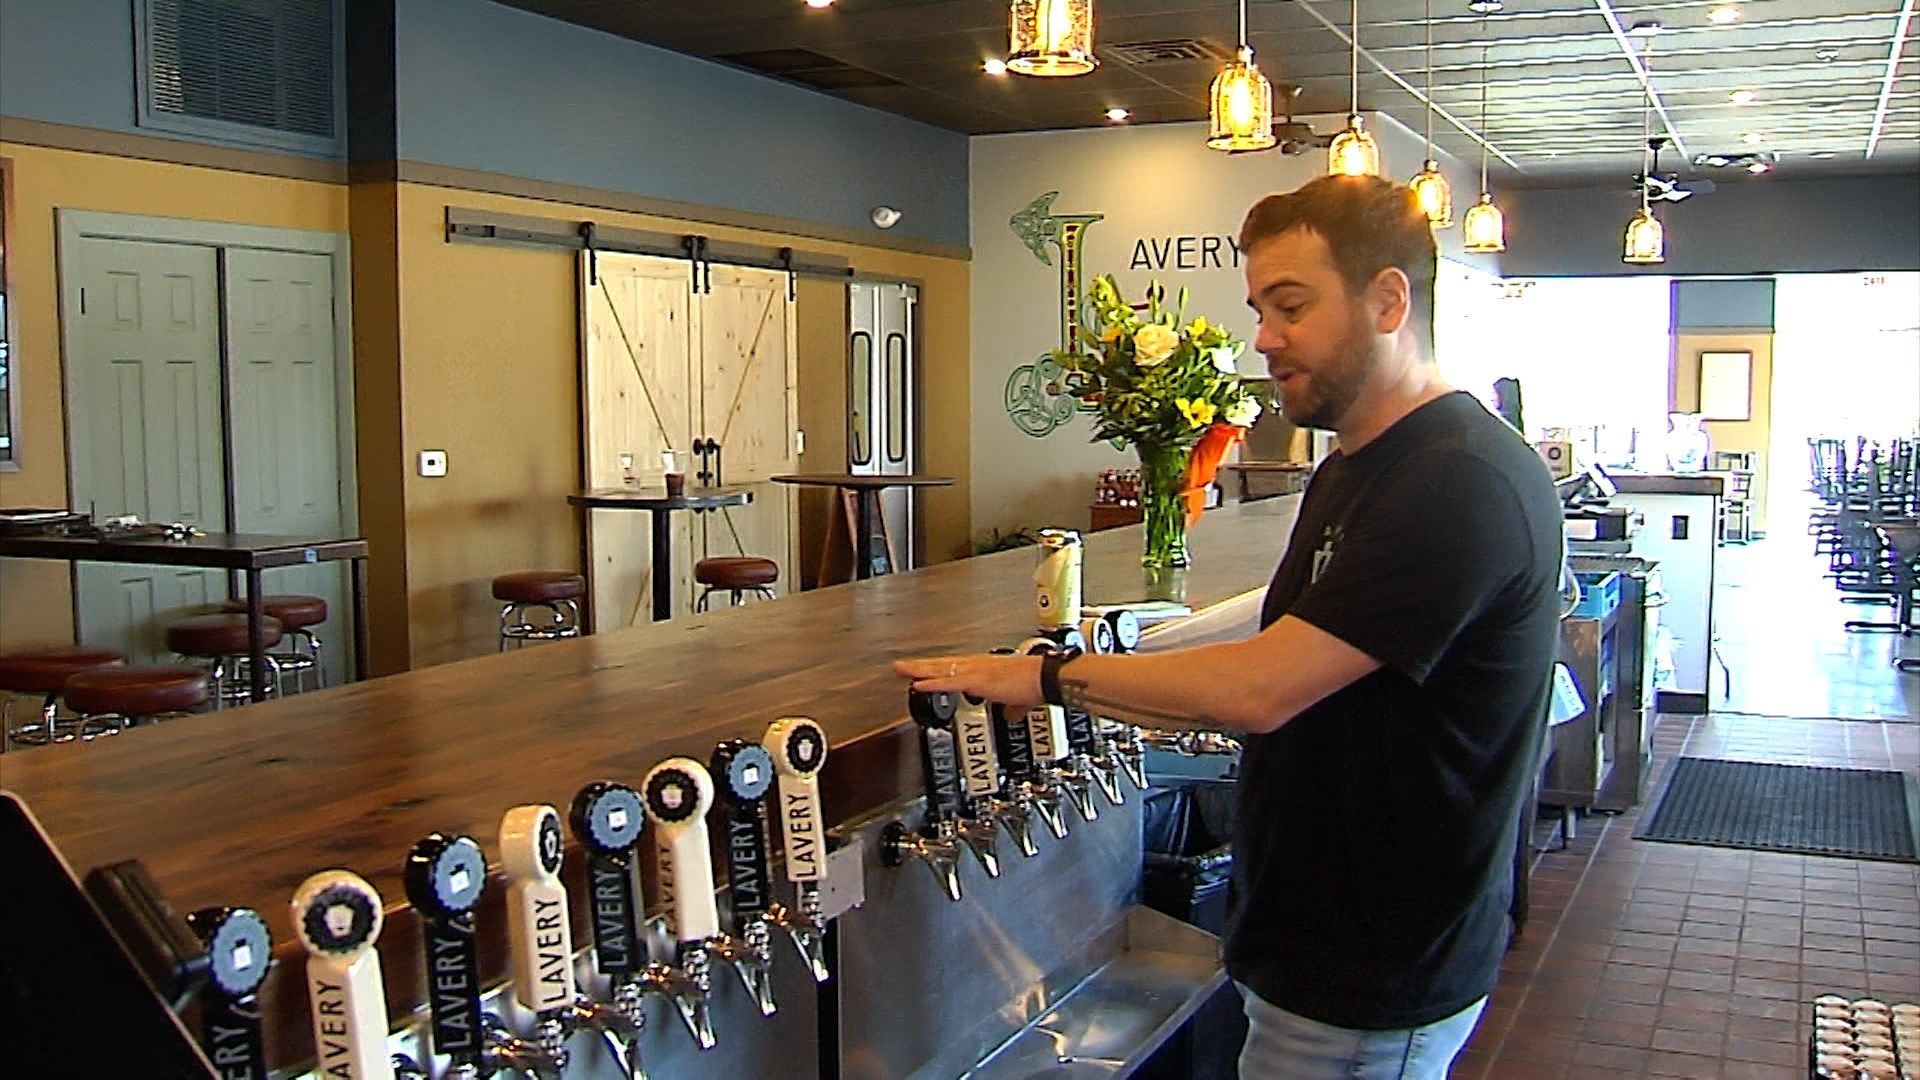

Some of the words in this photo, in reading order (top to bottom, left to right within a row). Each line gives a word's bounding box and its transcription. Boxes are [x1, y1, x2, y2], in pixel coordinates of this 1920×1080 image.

[963, 722, 992, 792] LAVERY
[1070, 707, 1091, 745] LAV
[729, 819, 761, 907] LAVERY
[788, 793, 817, 878] LAVERY
[535, 899, 567, 1003] LAVERY
[593, 868, 629, 966] LAVERY
[316, 979, 352, 1080] AVERY
[434, 937, 472, 1047] LAVERY
